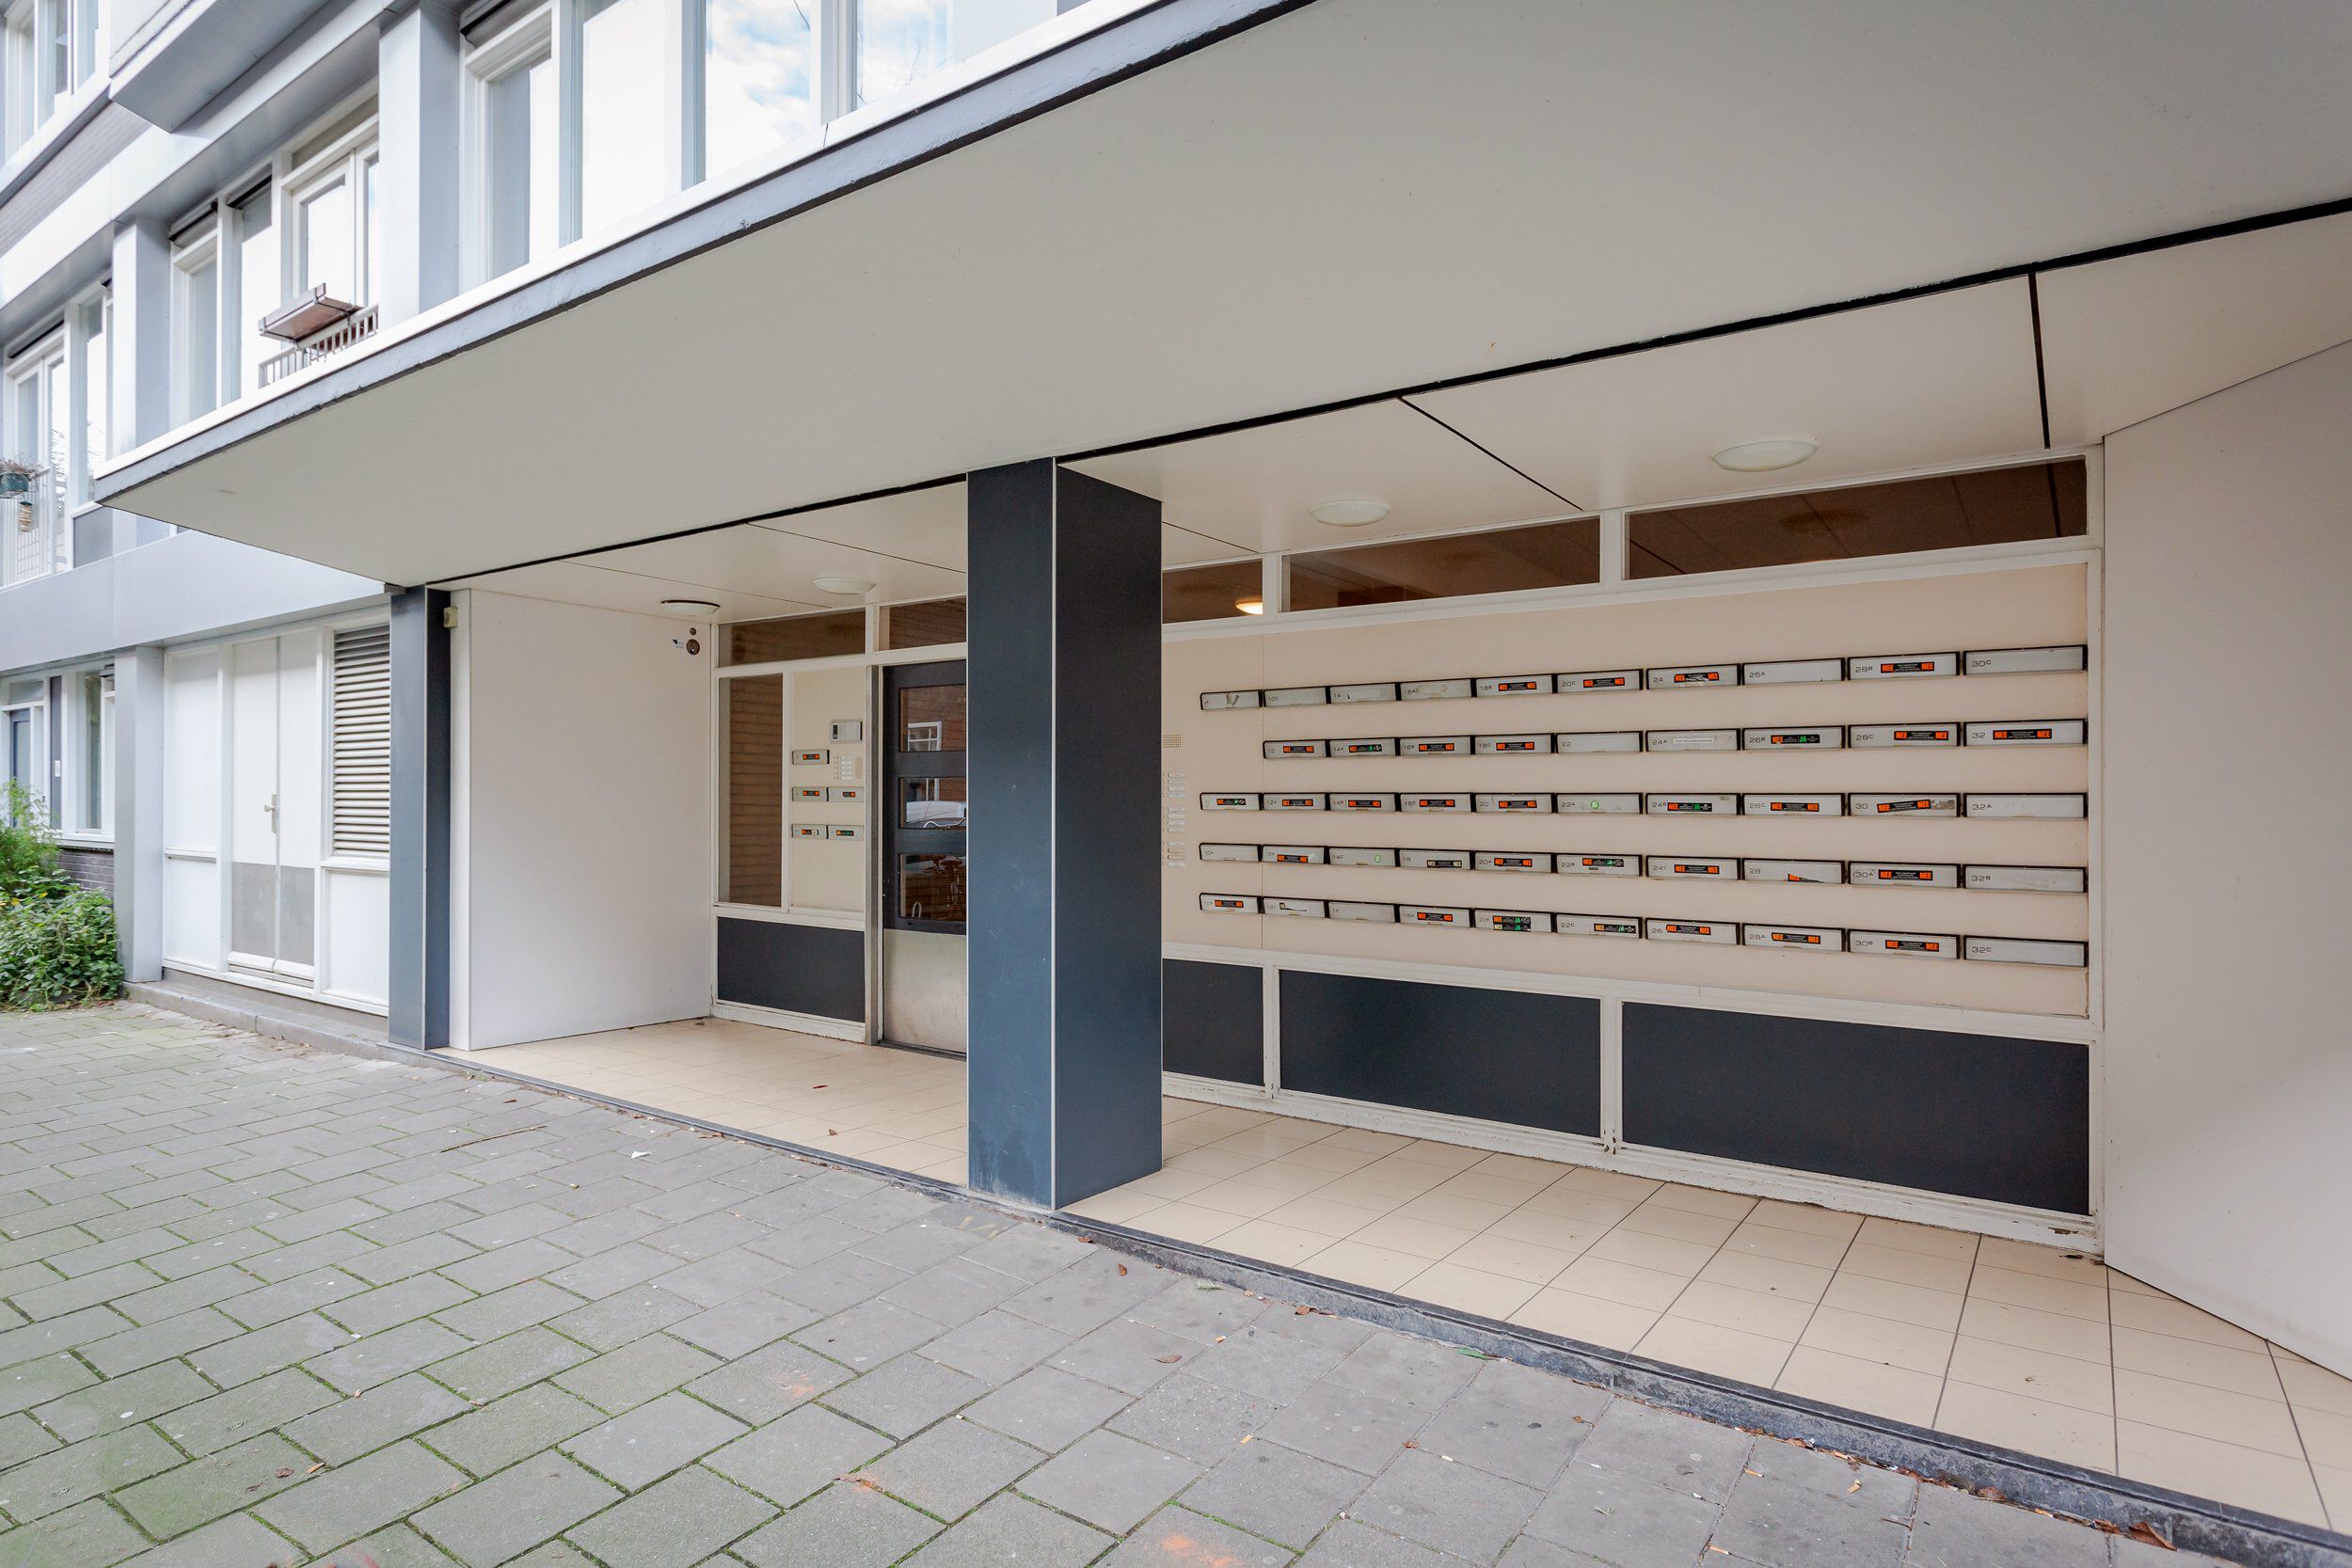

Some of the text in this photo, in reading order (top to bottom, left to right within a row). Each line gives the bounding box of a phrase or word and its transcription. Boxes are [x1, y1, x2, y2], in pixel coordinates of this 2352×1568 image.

[1882, 664, 1894, 673] NEE
[1921, 662, 1934, 671] NEE
[1971, 659, 1992, 668] 30C
[1614, 677, 1625, 686] NEE
[1895, 731, 1908, 739] NEE
[1935, 731, 1948, 739] NEE
[1994, 731, 2008, 739] NEE
[2036, 730, 2050, 738] NEE
[1878, 803, 1891, 812] NEE
[1916, 800, 1930, 809] NEE
[1880, 870, 1892, 879] NEE
[1807, 935, 1820, 943] NEE
[1925, 942, 1938, 951] NEE
